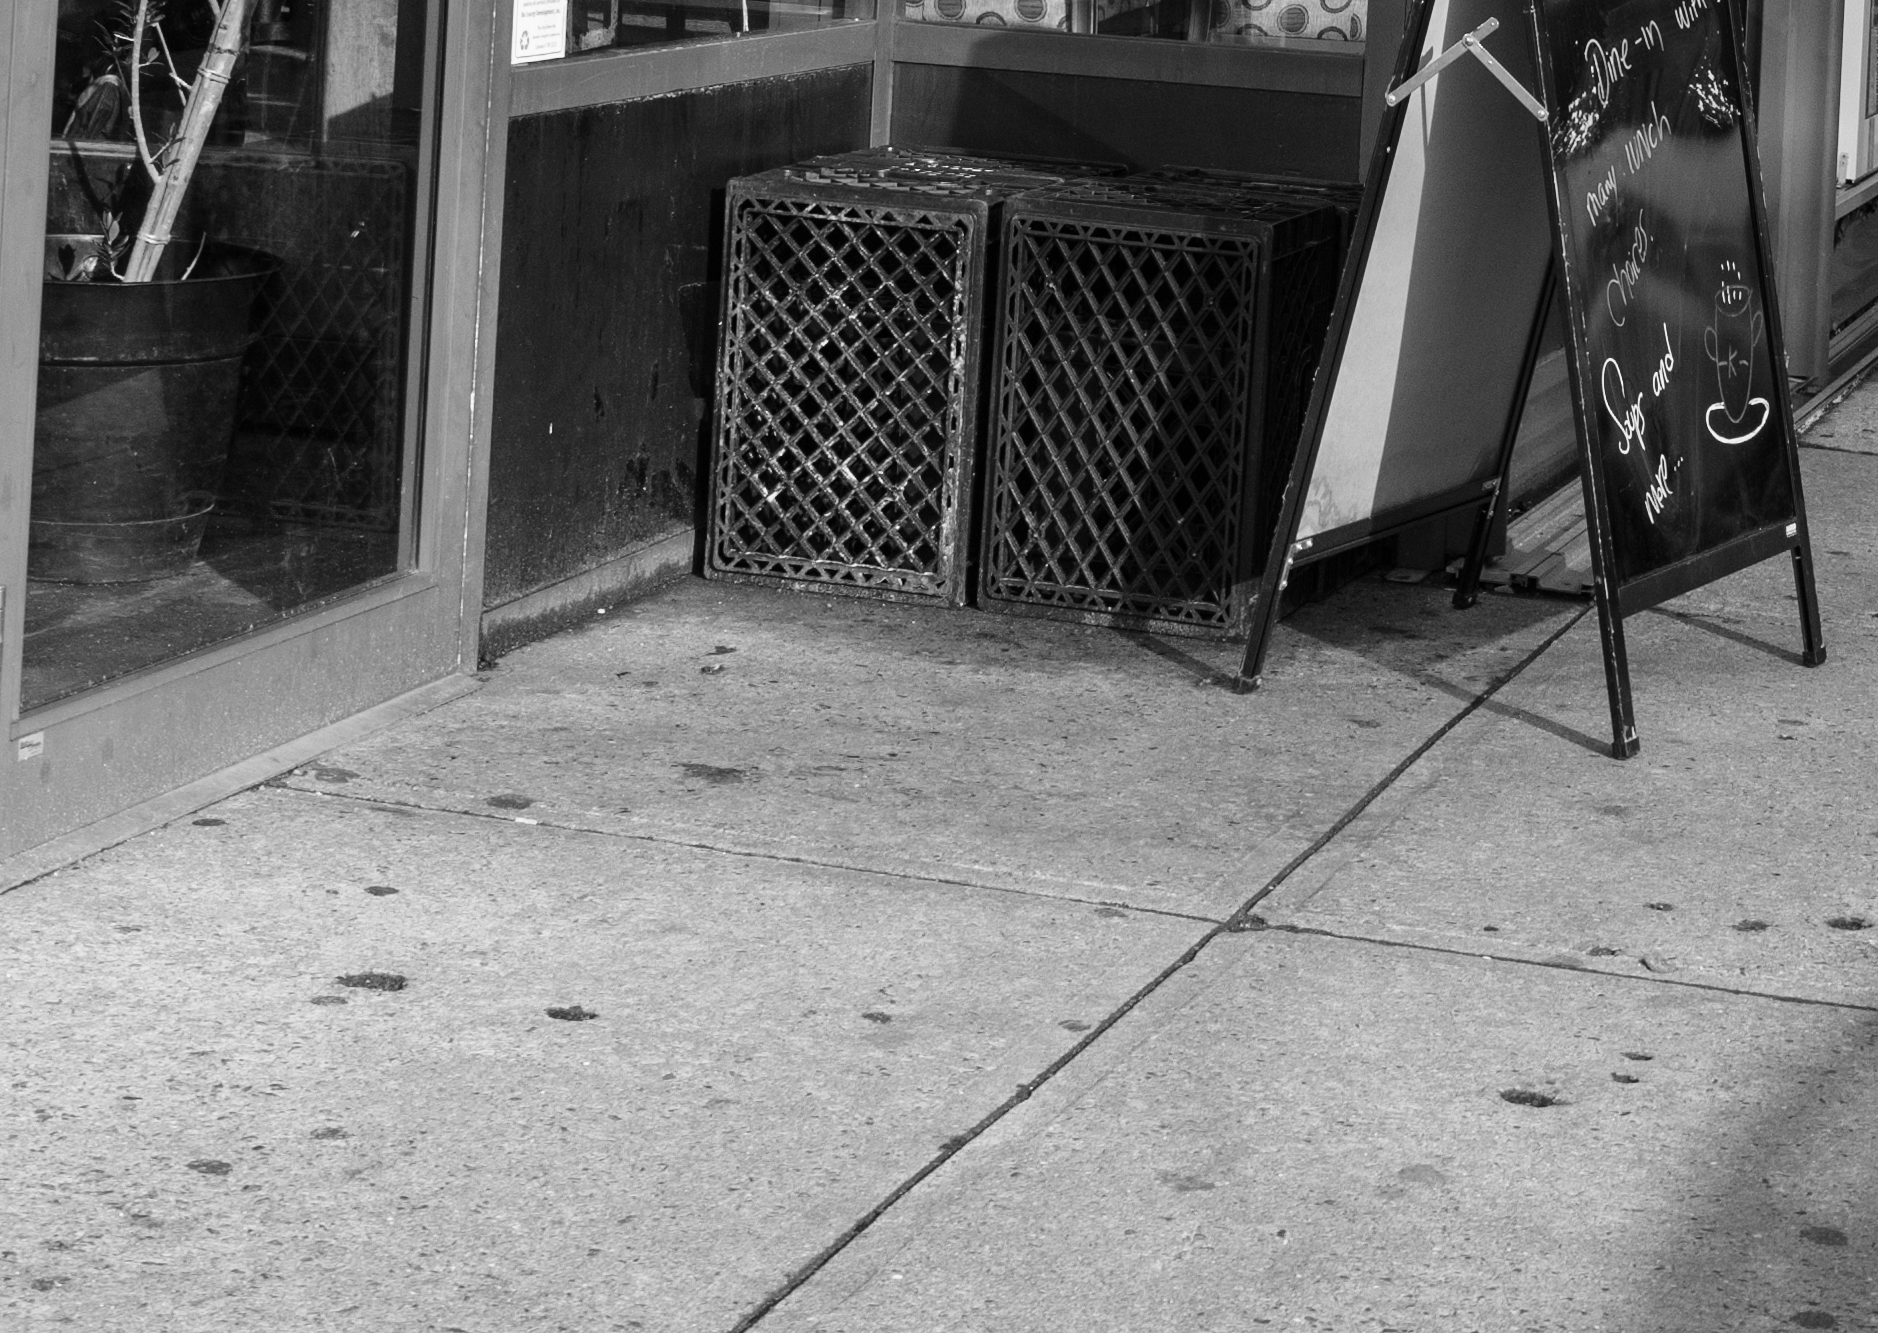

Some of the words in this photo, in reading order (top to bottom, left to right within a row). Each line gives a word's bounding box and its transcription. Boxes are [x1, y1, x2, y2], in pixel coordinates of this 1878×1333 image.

[1584, 20, 1664, 108] Dine-in
[1587, 165, 1618, 227] many
[1601, 358, 1646, 455] Soups
[1652, 322, 1674, 396] and
